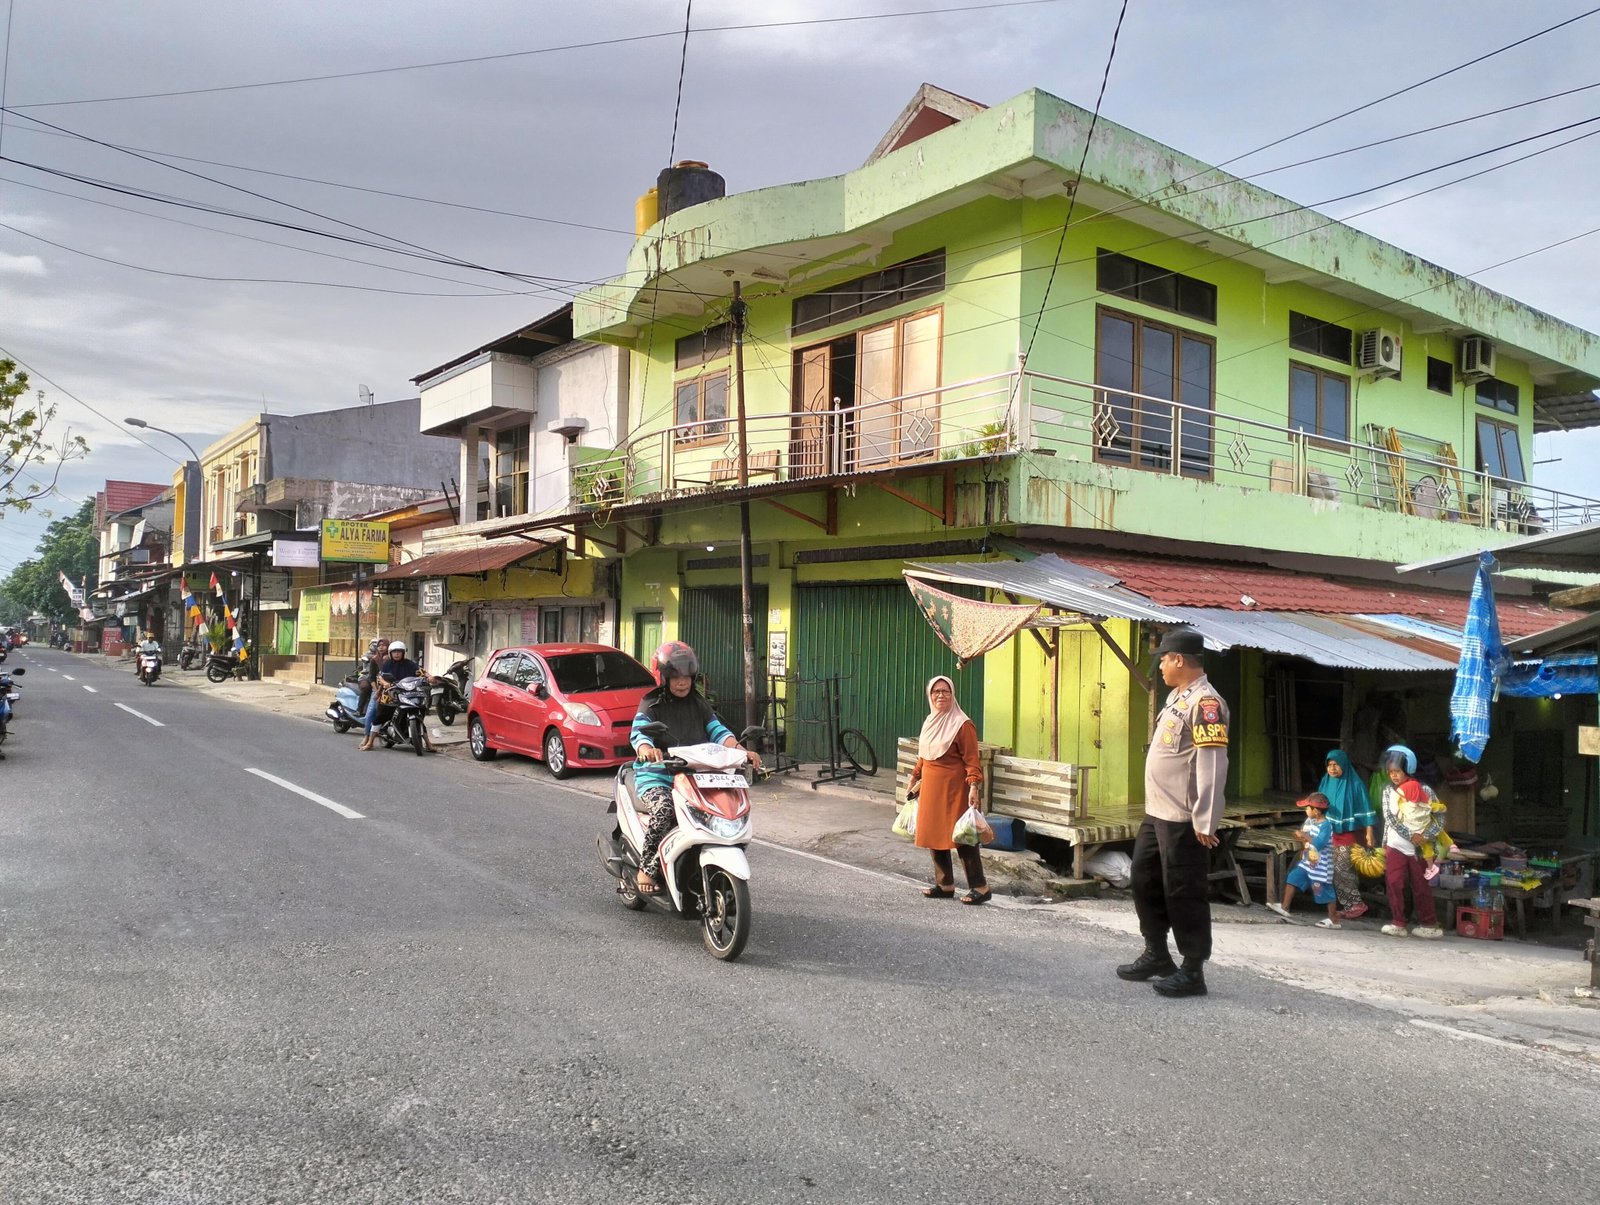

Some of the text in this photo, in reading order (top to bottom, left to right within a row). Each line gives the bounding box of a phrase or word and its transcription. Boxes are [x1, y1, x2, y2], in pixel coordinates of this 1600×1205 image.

[340, 527, 360, 541] ALYA
[361, 528, 387, 543] FARMA
[1193, 725, 1206, 739] KA
